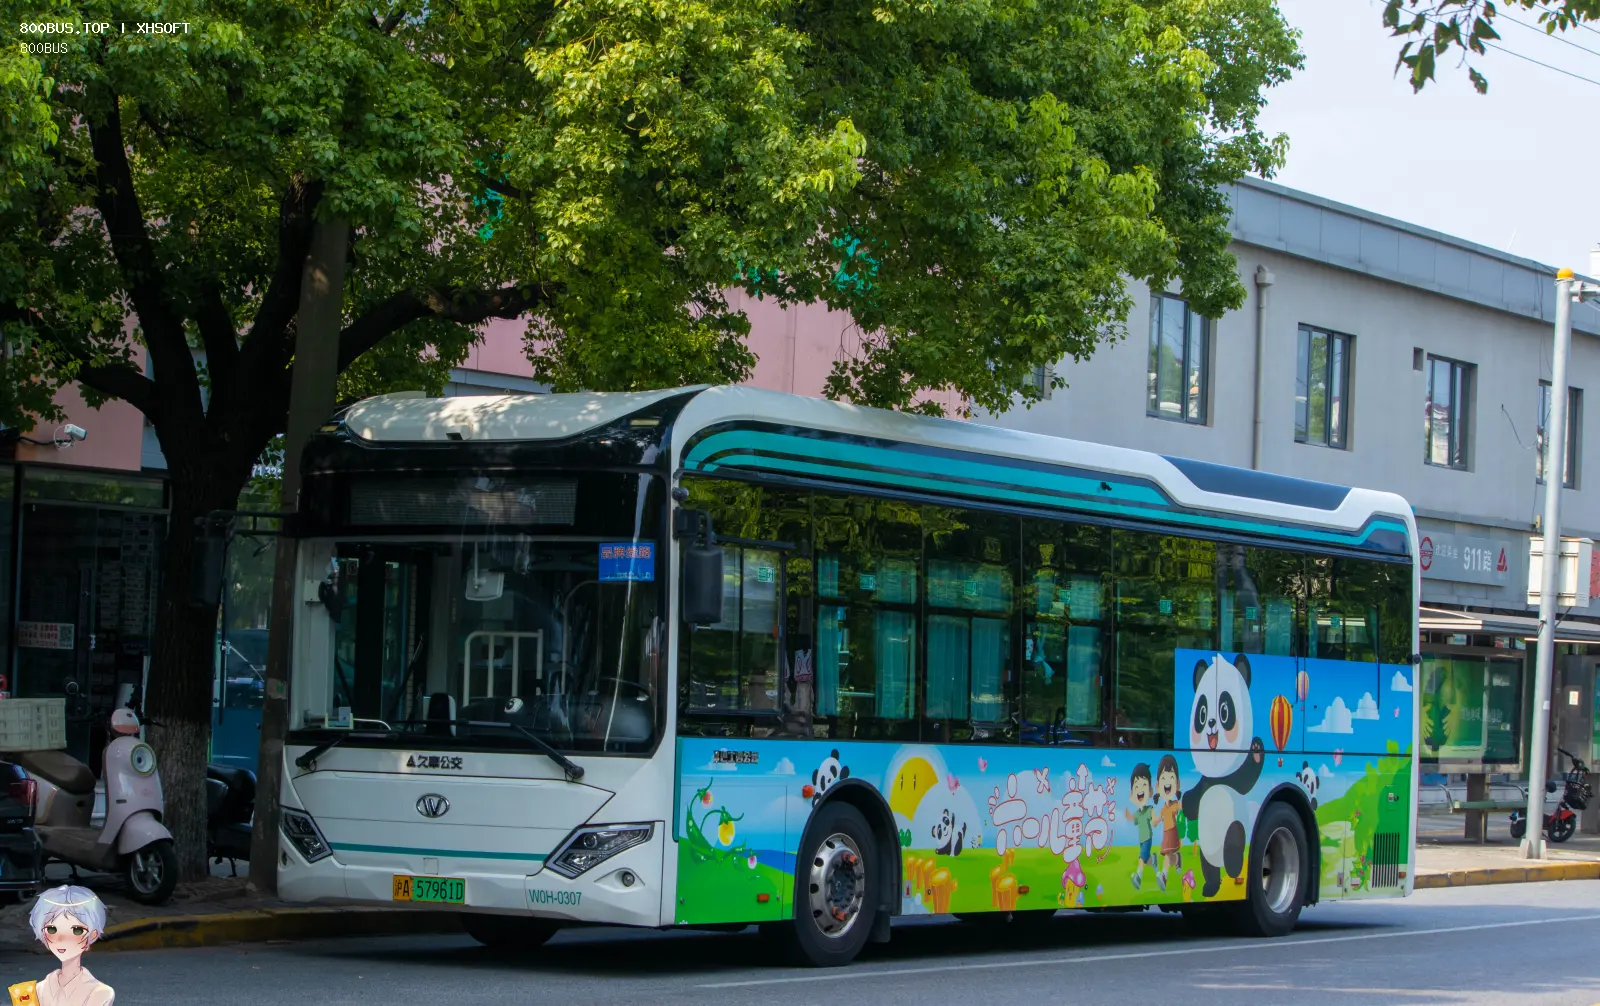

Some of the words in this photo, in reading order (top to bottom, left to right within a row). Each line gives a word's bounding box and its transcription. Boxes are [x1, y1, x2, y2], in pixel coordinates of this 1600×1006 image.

[601, 545, 651, 559] 品牌线路
[1464, 546, 1493, 573] 911路
[416, 879, 464, 901] 57961D
